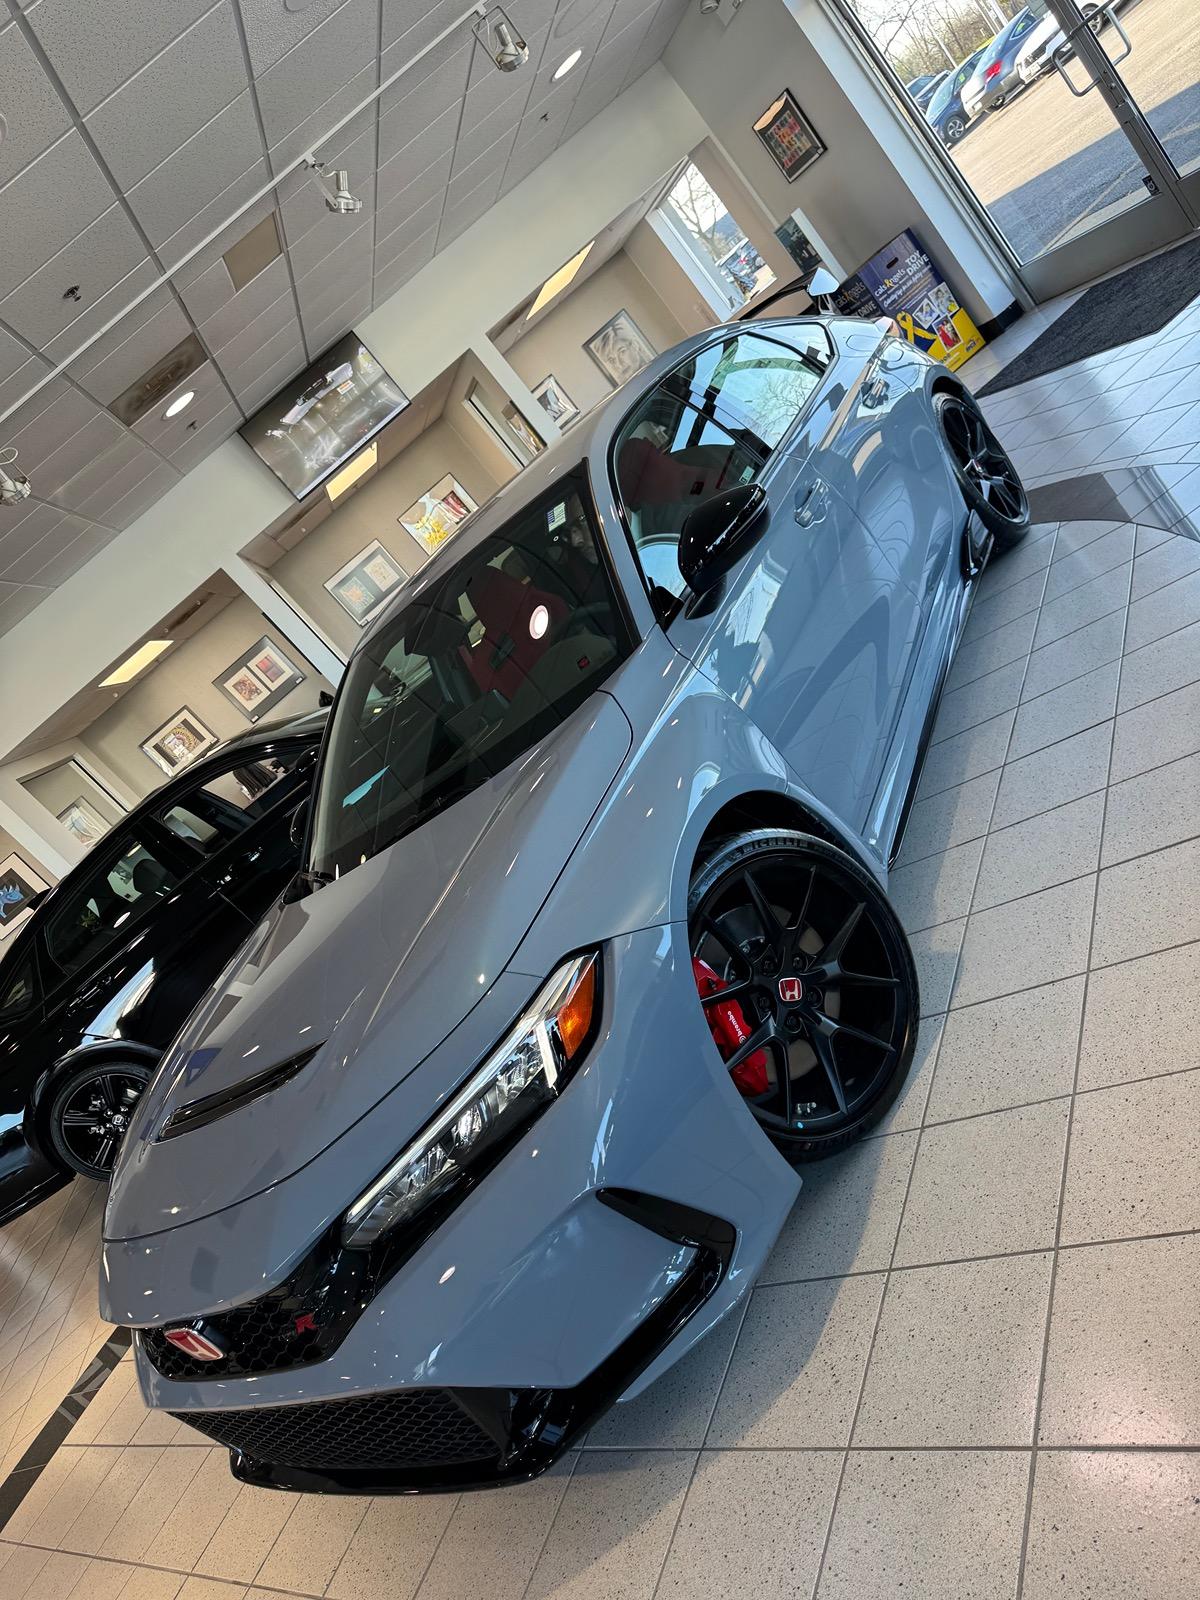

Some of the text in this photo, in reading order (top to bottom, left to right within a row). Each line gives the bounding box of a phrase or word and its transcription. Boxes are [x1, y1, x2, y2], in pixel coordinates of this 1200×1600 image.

[905, 250, 921, 265] TOY
[906, 254, 929, 275] DRIVE
[857, 300, 877, 317] DRIVE
[742, 837, 808, 854] MICHELIN
[727, 1010, 743, 1037] brembo
